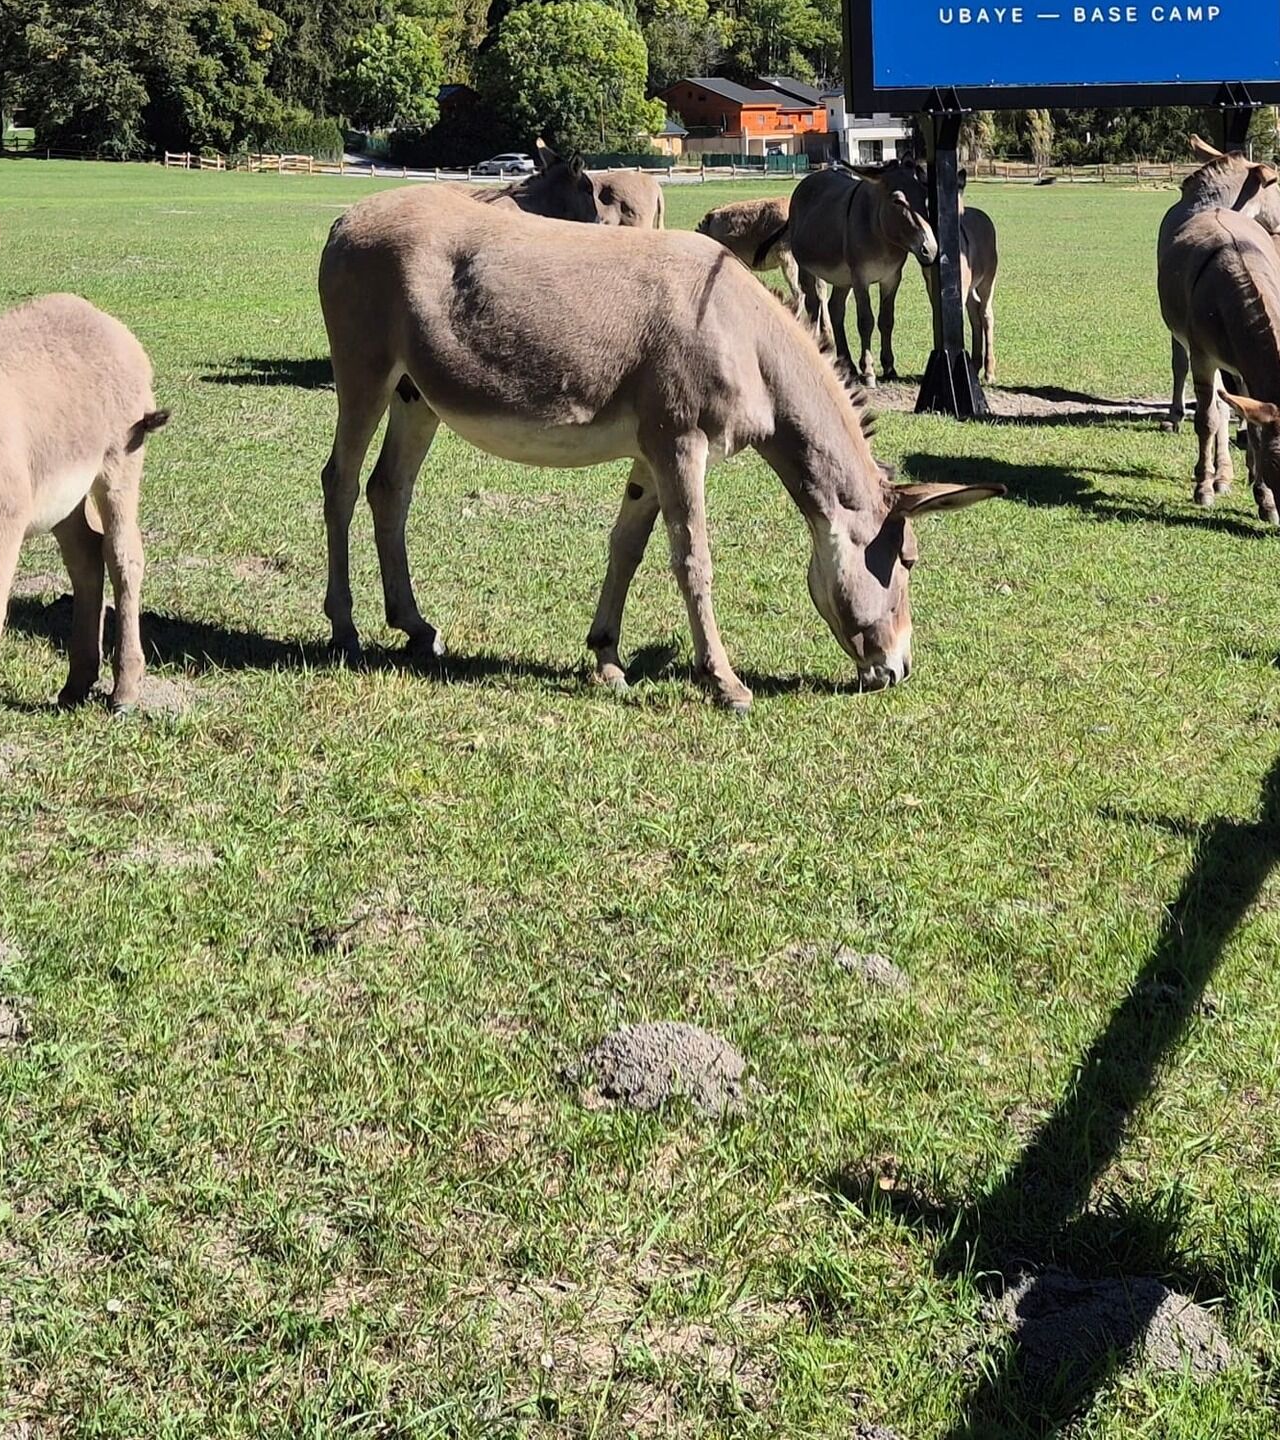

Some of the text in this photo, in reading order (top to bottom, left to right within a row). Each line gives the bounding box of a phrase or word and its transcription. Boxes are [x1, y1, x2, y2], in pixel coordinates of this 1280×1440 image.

[939, 7, 1024, 24] UBAYE
[1073, 6, 1138, 23] BASE
[1151, 5, 1221, 22] CAMP
